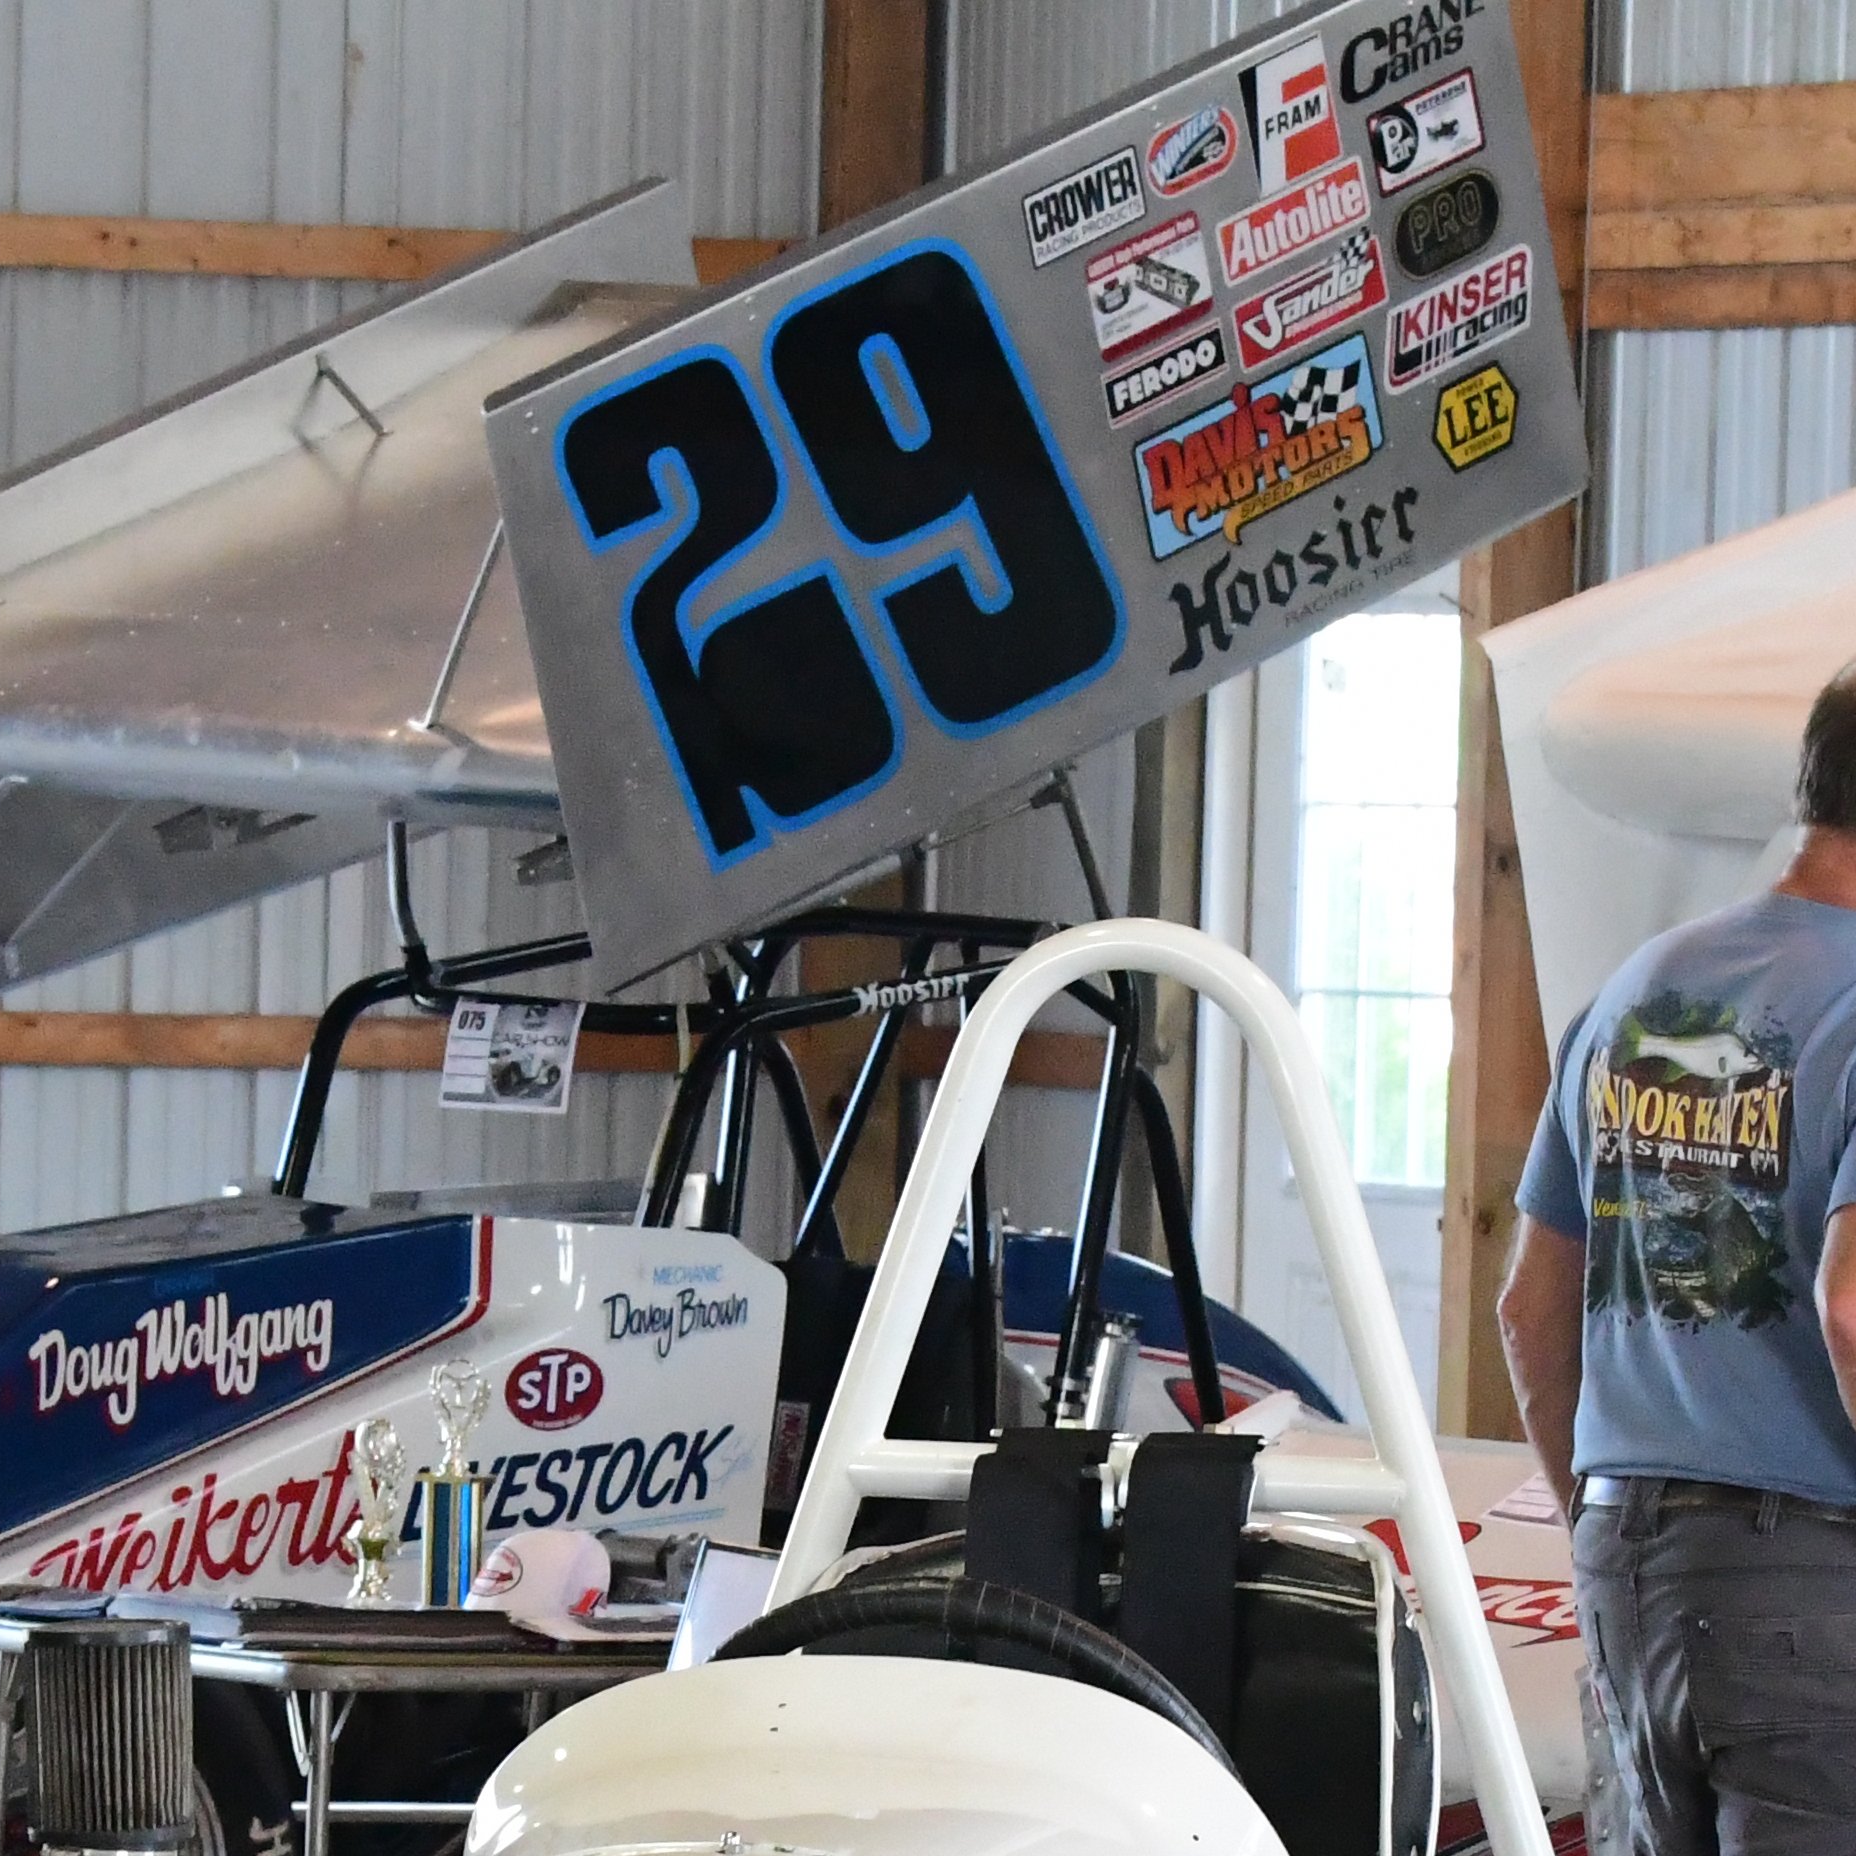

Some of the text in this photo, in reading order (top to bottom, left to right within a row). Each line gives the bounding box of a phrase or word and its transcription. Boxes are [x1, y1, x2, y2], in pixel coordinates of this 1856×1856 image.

[1264, 94, 1321, 141] FRAM
[1029, 156, 1138, 243] CROWER
[1230, 178, 1364, 277] Autolite
[1408, 181, 1483, 254] PRO
[1242, 257, 1375, 350] Sander
[1401, 250, 1528, 348] KINSER
[1451, 290, 1528, 347] racing
[1112, 339, 1217, 411] FERODO
[1443, 383, 1511, 450] LEE
[1192, 406, 1373, 522] MOTORS
[1240, 482, 1293, 519] SPEED
[554, 235, 1128, 874] 29
[1168, 486, 1420, 676] Hoosier
[458, 1010, 486, 1031] 075
[653, 1265, 724, 1287] MECHANIC
[28, 1291, 333, 1426] Doug Wolfgang
[603, 1287, 749, 1359] Davey Brown
[517, 1353, 592, 1414] STP
[399, 1424, 735, 1543] LVESTOCK
